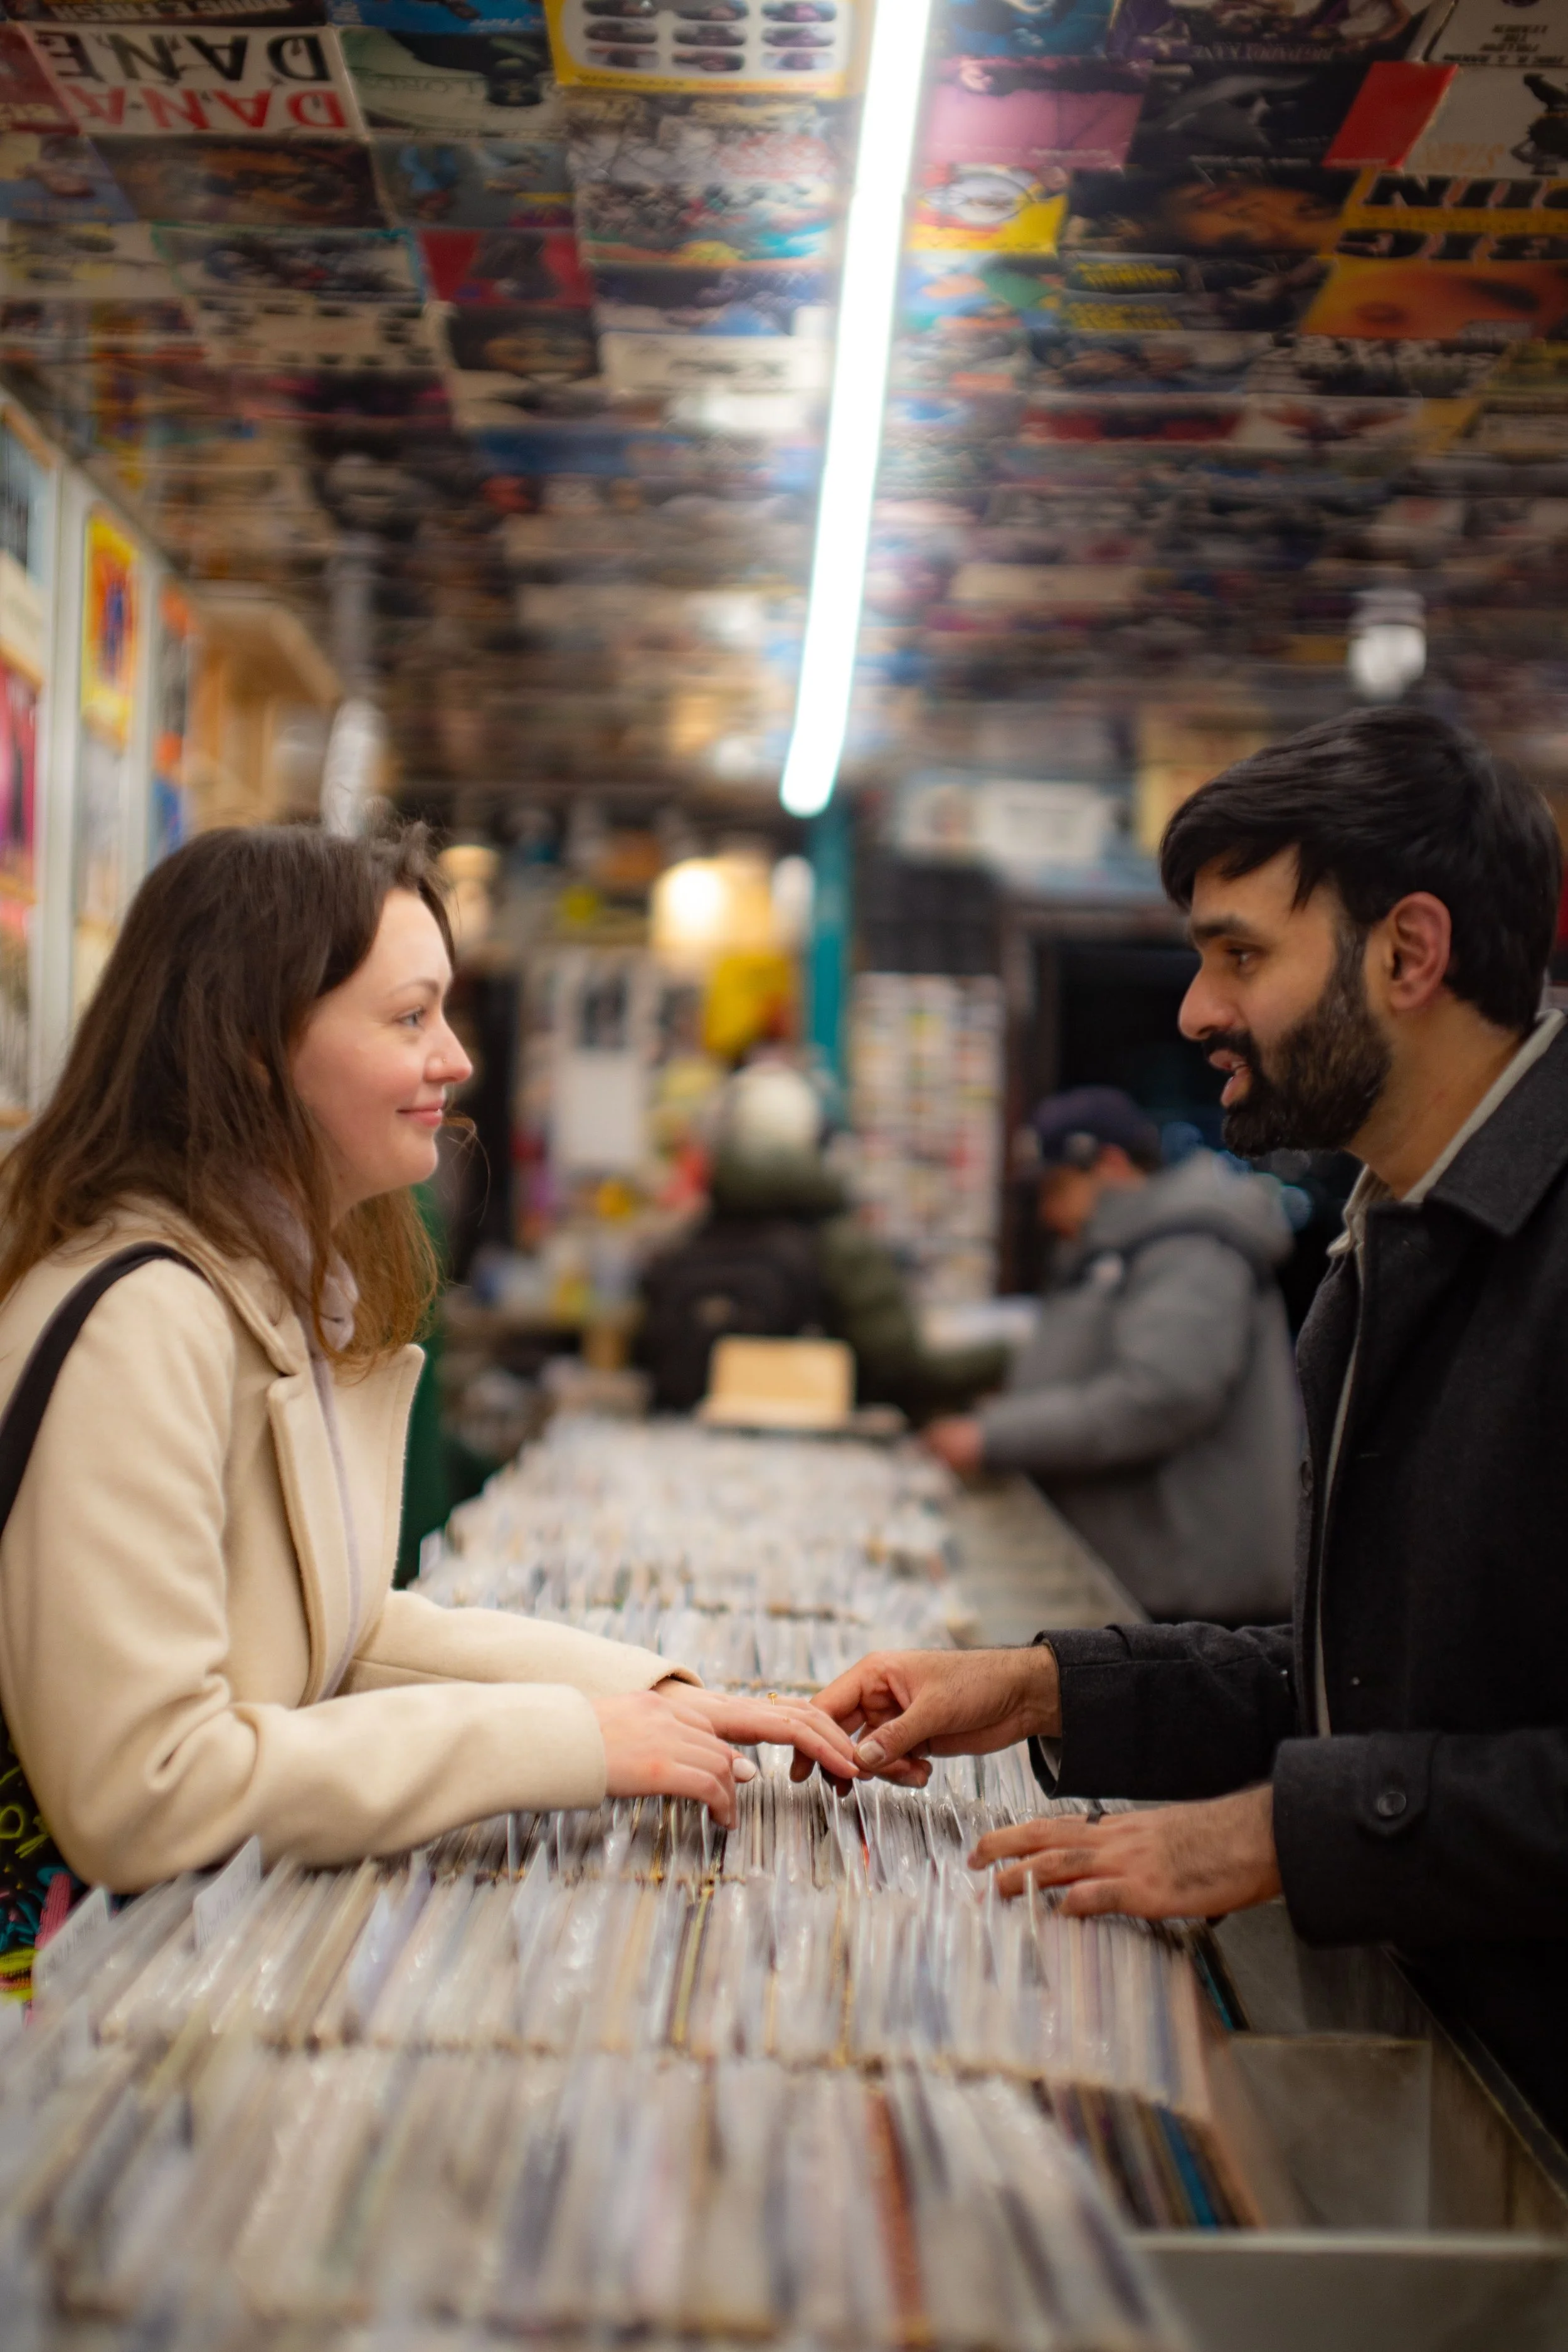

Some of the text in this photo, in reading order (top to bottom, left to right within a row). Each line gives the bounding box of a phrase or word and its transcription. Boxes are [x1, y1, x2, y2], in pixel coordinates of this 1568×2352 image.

[49, 3, 163, 21] FRESH
[34, 31, 331, 83] DANE
[65, 86, 347, 129] DANA
